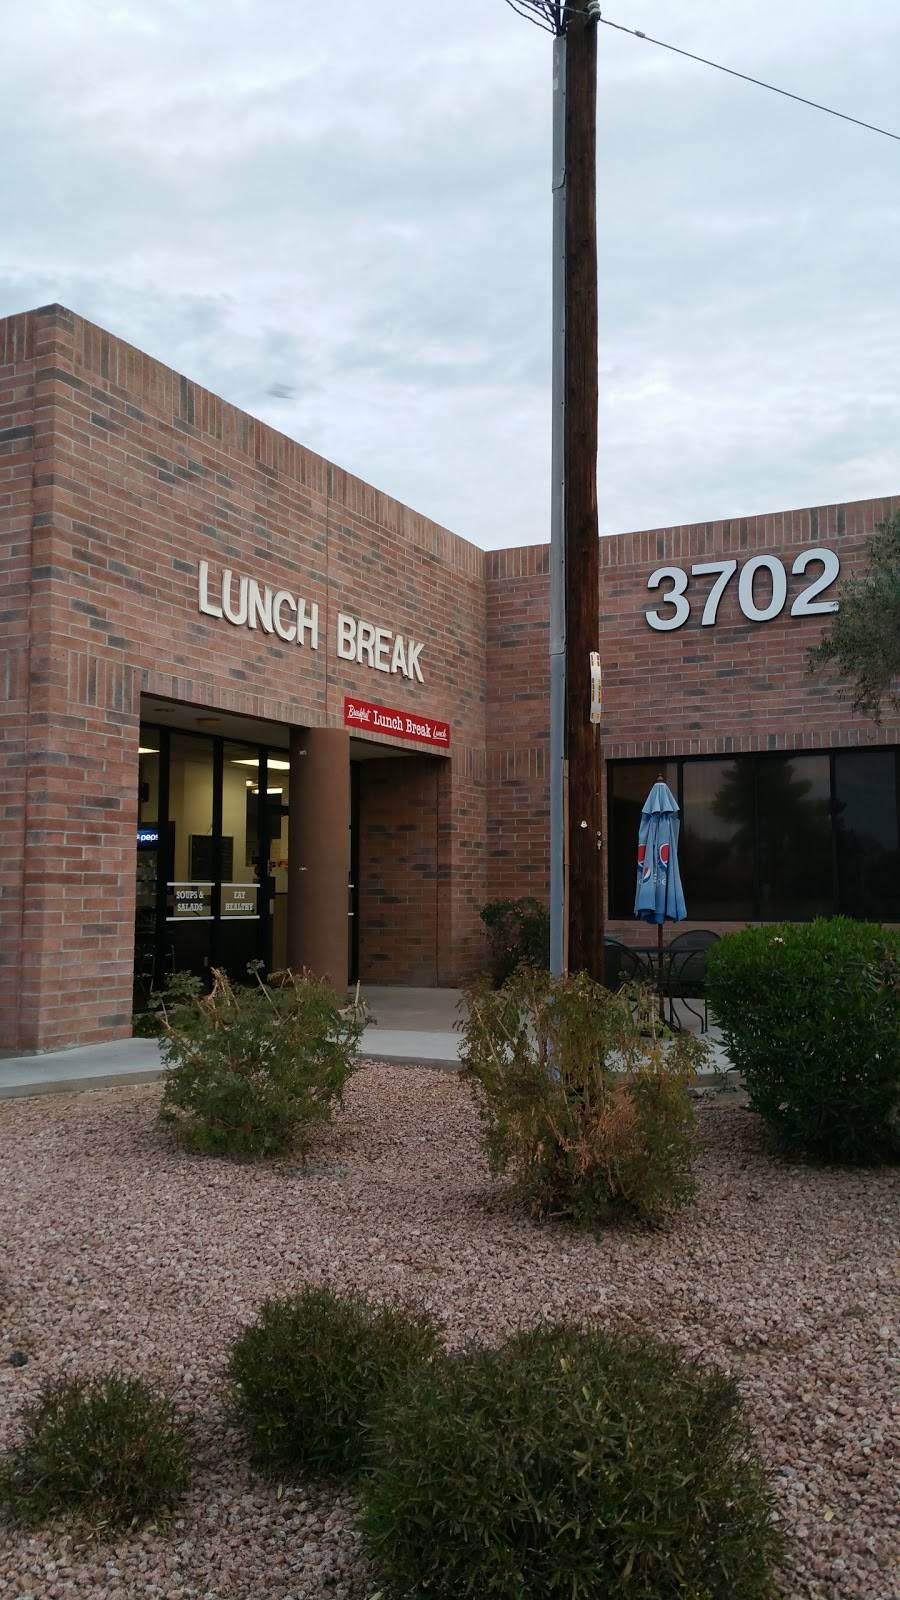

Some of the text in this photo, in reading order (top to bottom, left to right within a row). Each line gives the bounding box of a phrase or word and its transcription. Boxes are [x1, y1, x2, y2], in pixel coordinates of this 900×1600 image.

[645, 547, 840, 631] 3702
[198, 560, 425, 683] LUNCH BREAK
[373, 711, 403, 731] Lunch
[406, 719, 431, 738] Break
[176, 891, 204, 899] SOUPS &
[233, 891, 246, 899] EAT
[177, 903, 203, 912] SALADS
[225, 903, 254, 911] HEALTHY
